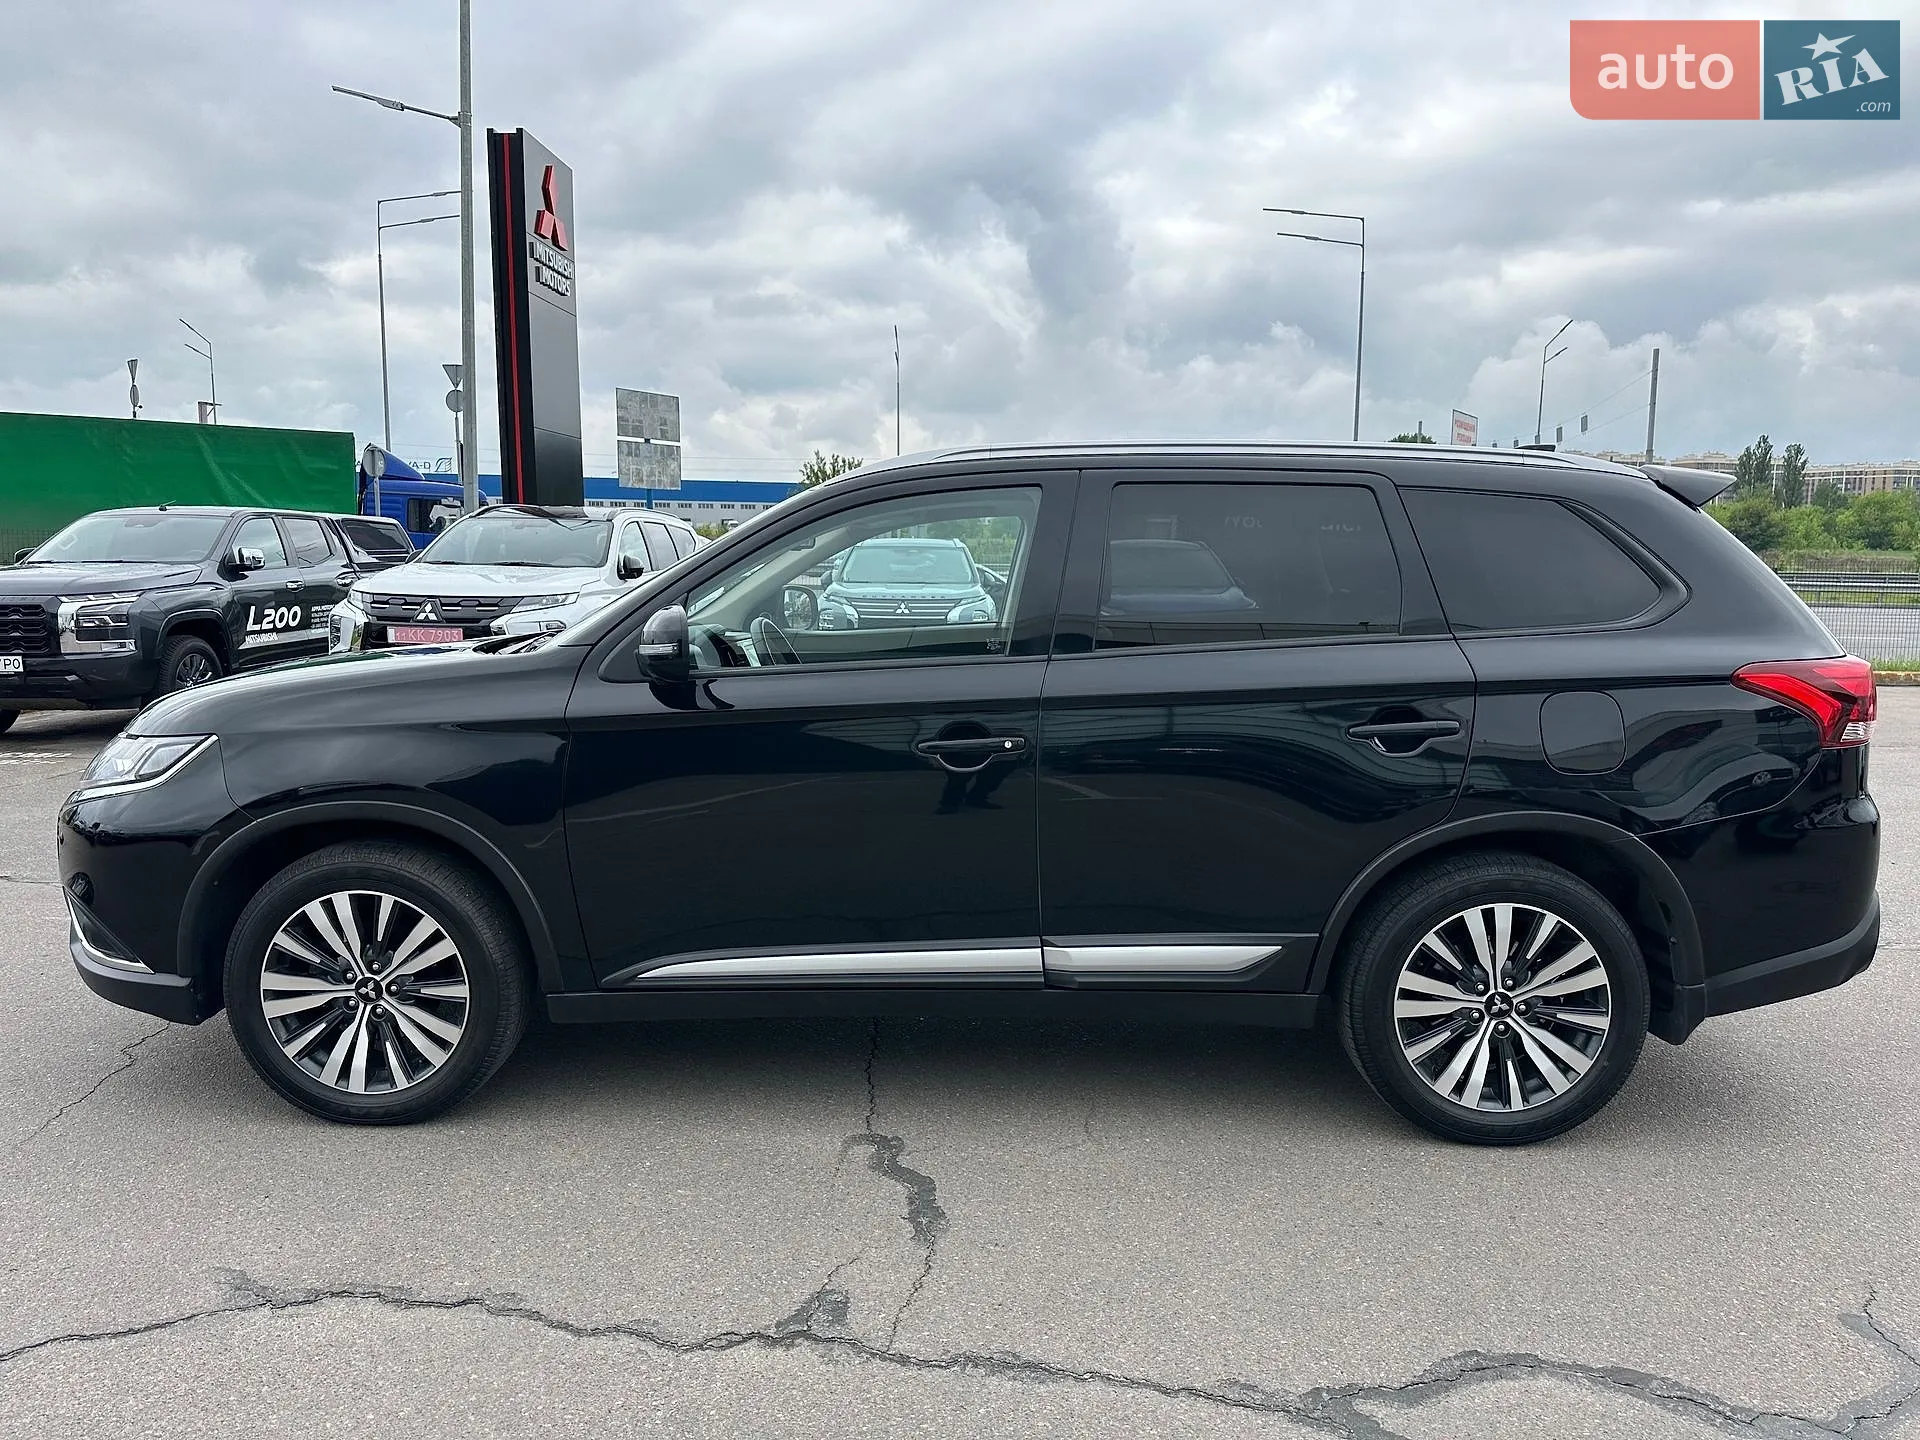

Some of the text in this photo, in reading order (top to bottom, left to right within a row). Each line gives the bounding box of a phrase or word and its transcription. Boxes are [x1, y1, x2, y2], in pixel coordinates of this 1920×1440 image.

[536, 266, 571, 296] MOTORS
[246, 605, 302, 632] L200
[408, 629, 425, 641] KK
[430, 630, 460, 642] 7903
